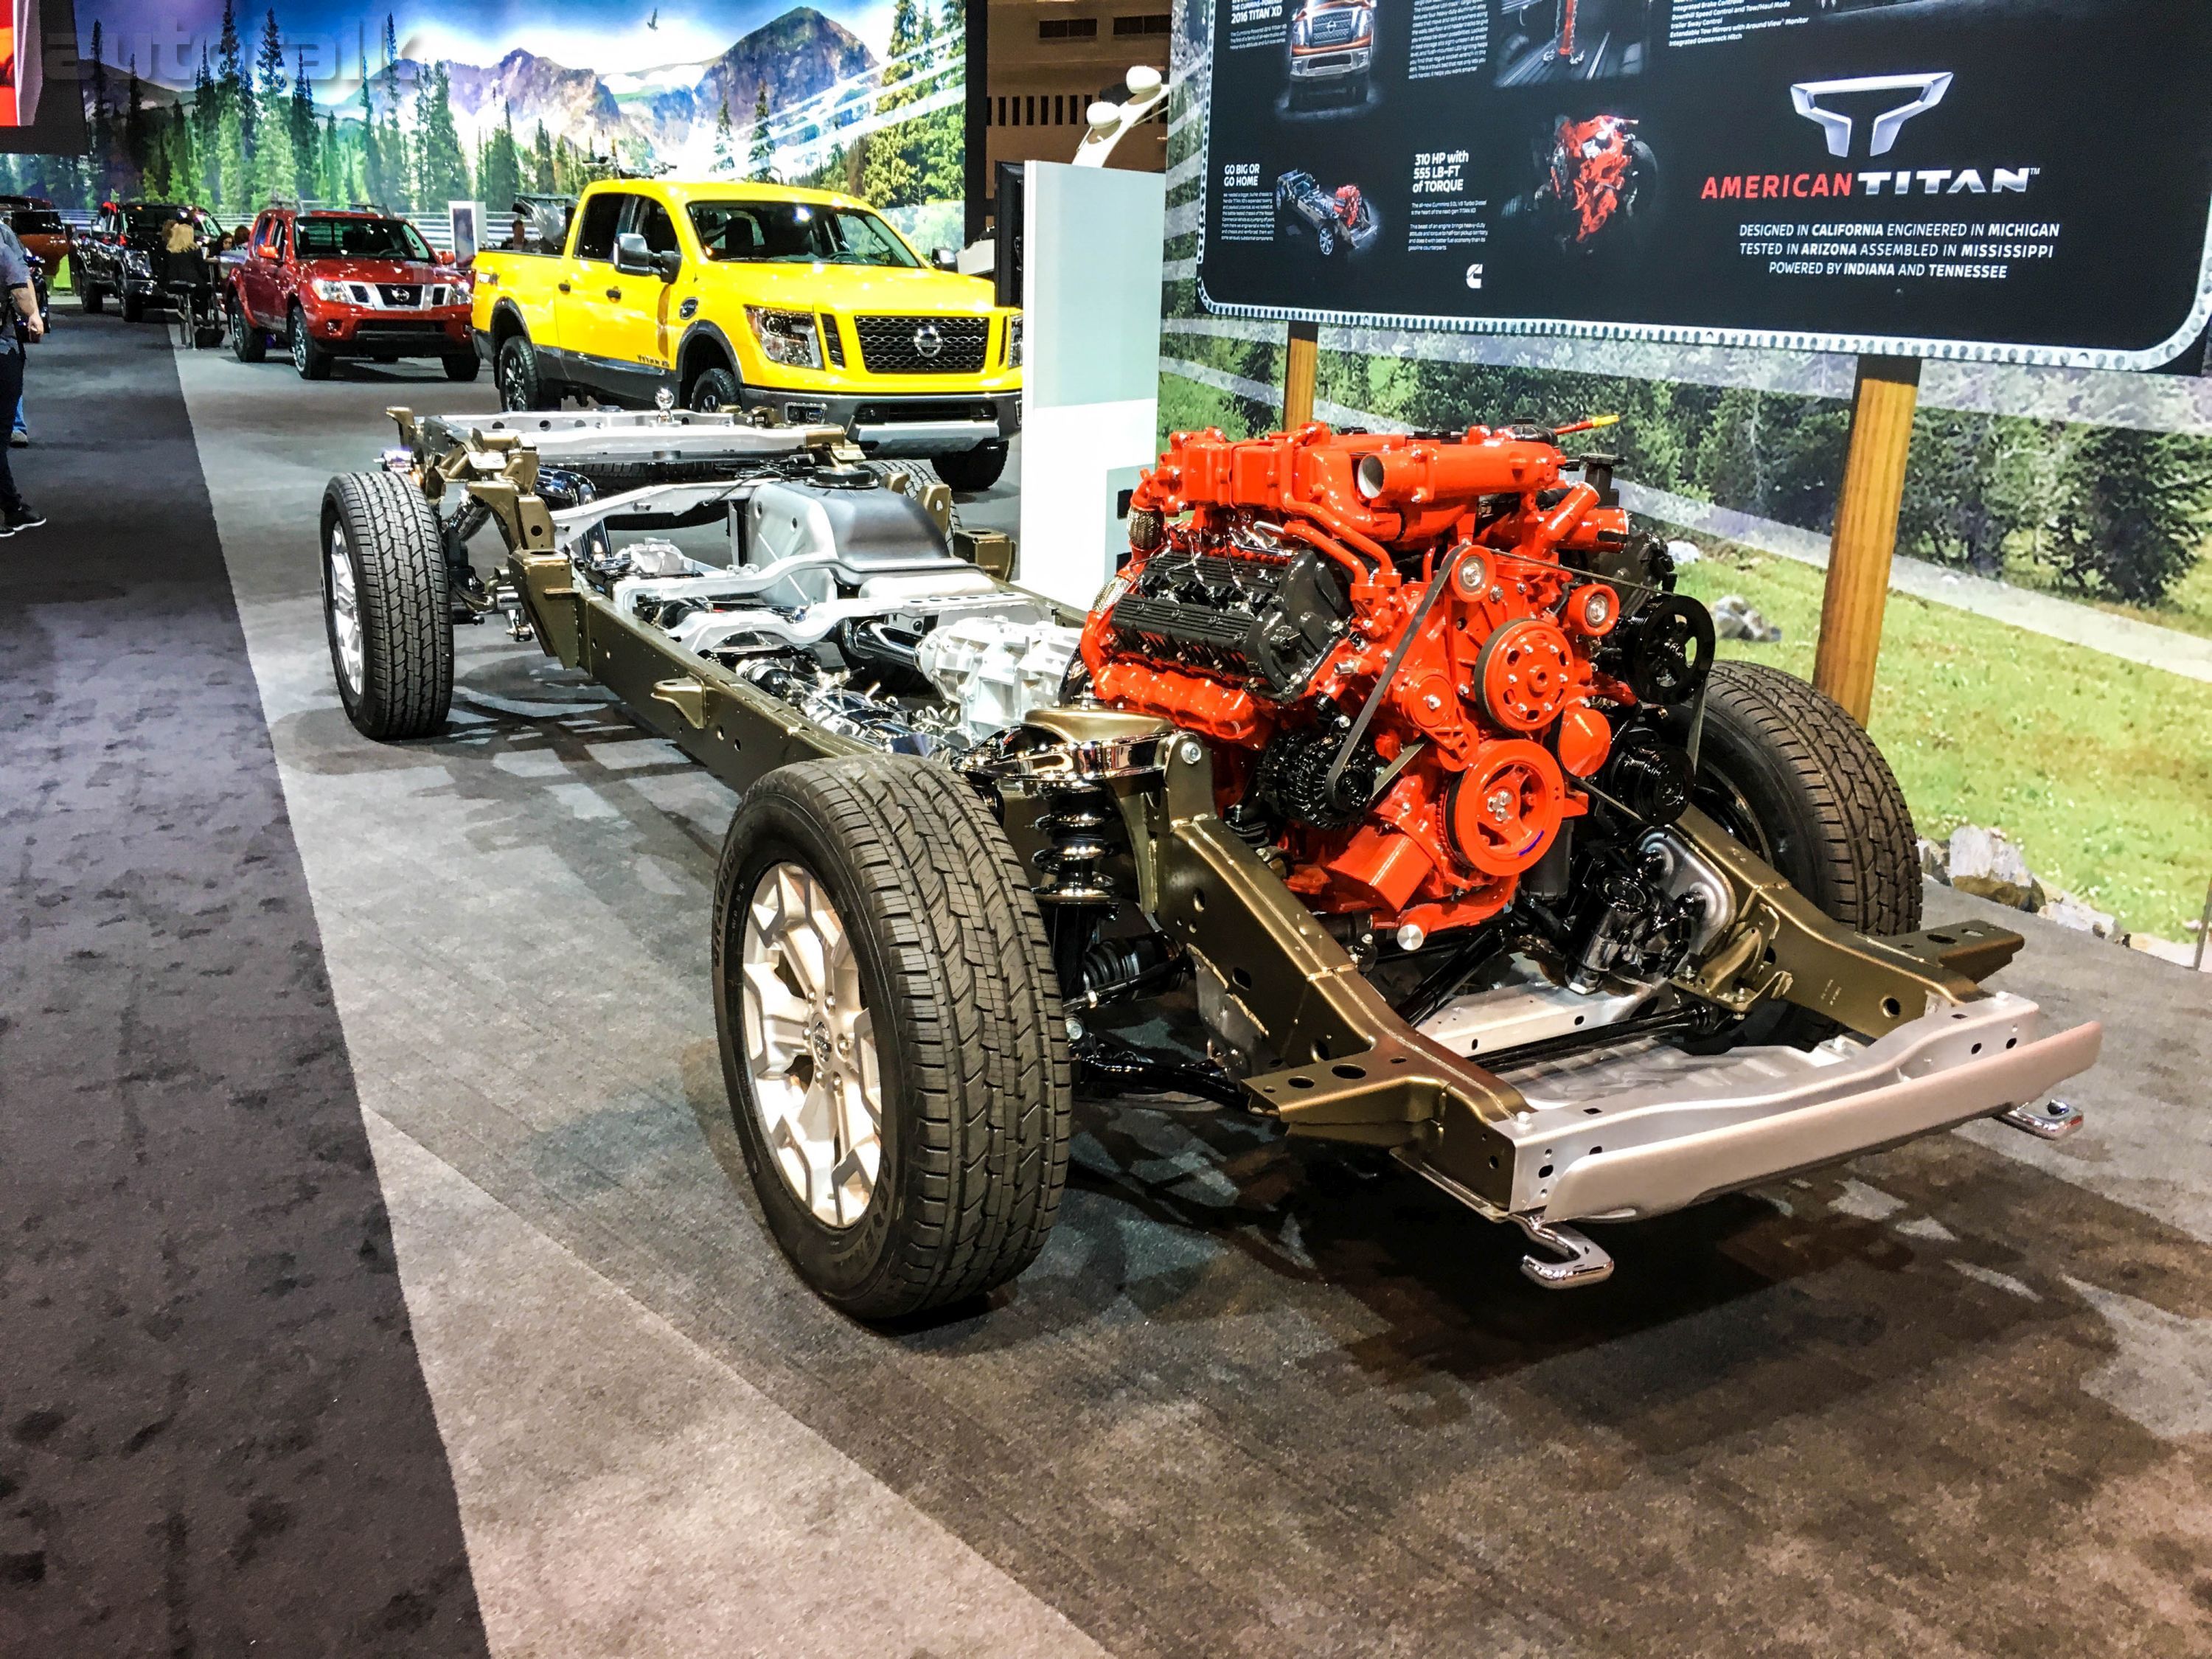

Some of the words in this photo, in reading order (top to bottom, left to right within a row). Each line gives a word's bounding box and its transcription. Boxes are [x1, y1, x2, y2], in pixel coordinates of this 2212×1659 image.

[1231, 11, 1248, 24] 2016
[1248, 8, 1270, 20] TITAN
[1270, 6, 1283, 18] XD
[1415, 153, 1430, 165] 310
[1432, 152, 1445, 164] HP
[1447, 150, 1469, 164] with
[1224, 164, 1234, 175] GO
[1236, 164, 1248, 175] BIG
[1249, 163, 1259, 174] OR
[1413, 167, 1430, 179] 555
[1432, 165, 1461, 178] LB-FT
[1224, 176, 1234, 187] GO
[1236, 175, 1258, 187] HOME
[1413, 181, 1423, 193] of
[1425, 178, 1464, 192] TORQUE
[1701, 173, 1852, 199] AMERICAN
[1739, 224, 1793, 236] DESIGNED
[1796, 224, 1809, 236] IN
[1812, 224, 1885, 236] CALIFORNIA
[1888, 223, 1968, 236] ENGINEERED
[1971, 223, 1986, 236] IN
[1989, 223, 2060, 236] MICHIGAN
[1740, 243, 1782, 255] TESTED
[1785, 243, 1798, 255] IN
[1801, 243, 1856, 256] ARIZONA
[1859, 243, 1940, 257] ASSEMBLED
[1943, 244, 1958, 257] IN
[1961, 244, 2053, 258] MISSISSIPPI
[1770, 262, 1822, 274] POWERED
[1826, 263, 1841, 274] BY
[1844, 263, 1893, 276] INDIANA
[1897, 264, 1924, 276] AND
[1927, 264, 2007, 278] TENNESSEE
